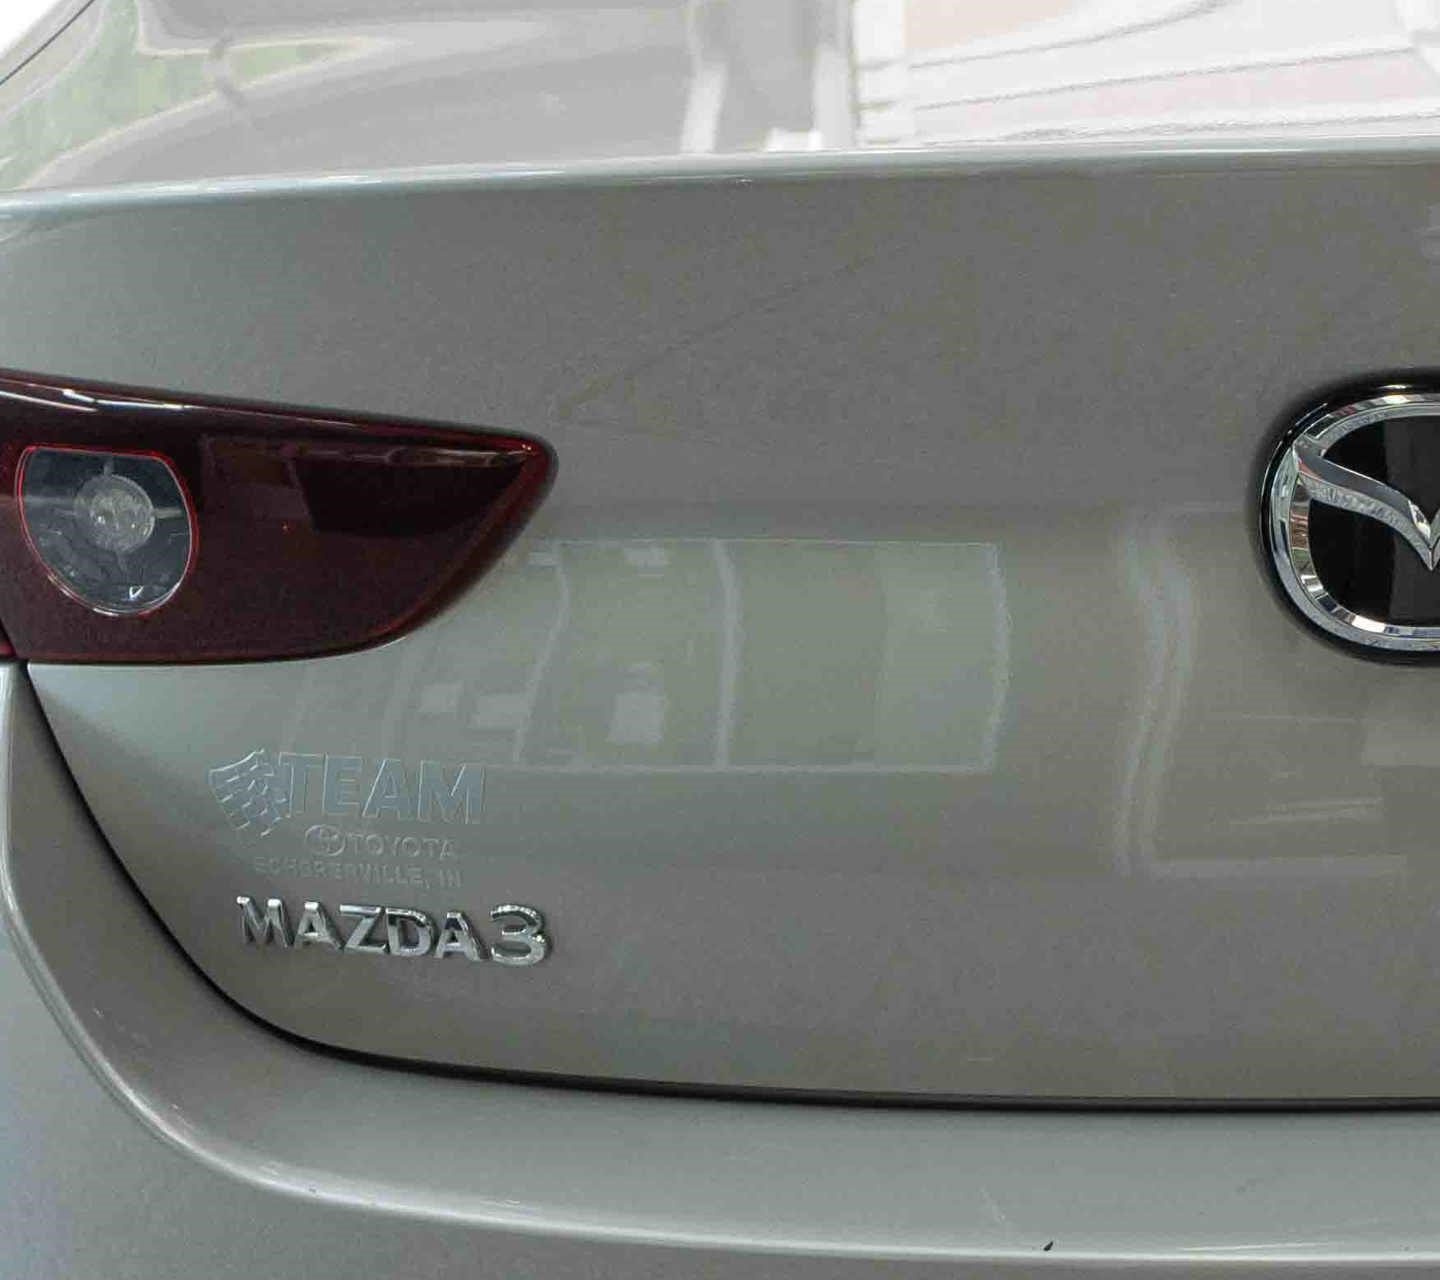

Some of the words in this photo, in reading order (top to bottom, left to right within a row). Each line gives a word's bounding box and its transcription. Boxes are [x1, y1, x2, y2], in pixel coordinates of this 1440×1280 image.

[277, 750, 486, 824] TEAM
[348, 832, 455, 860] TOYOTA
[236, 895, 553, 967] MAZDA3
